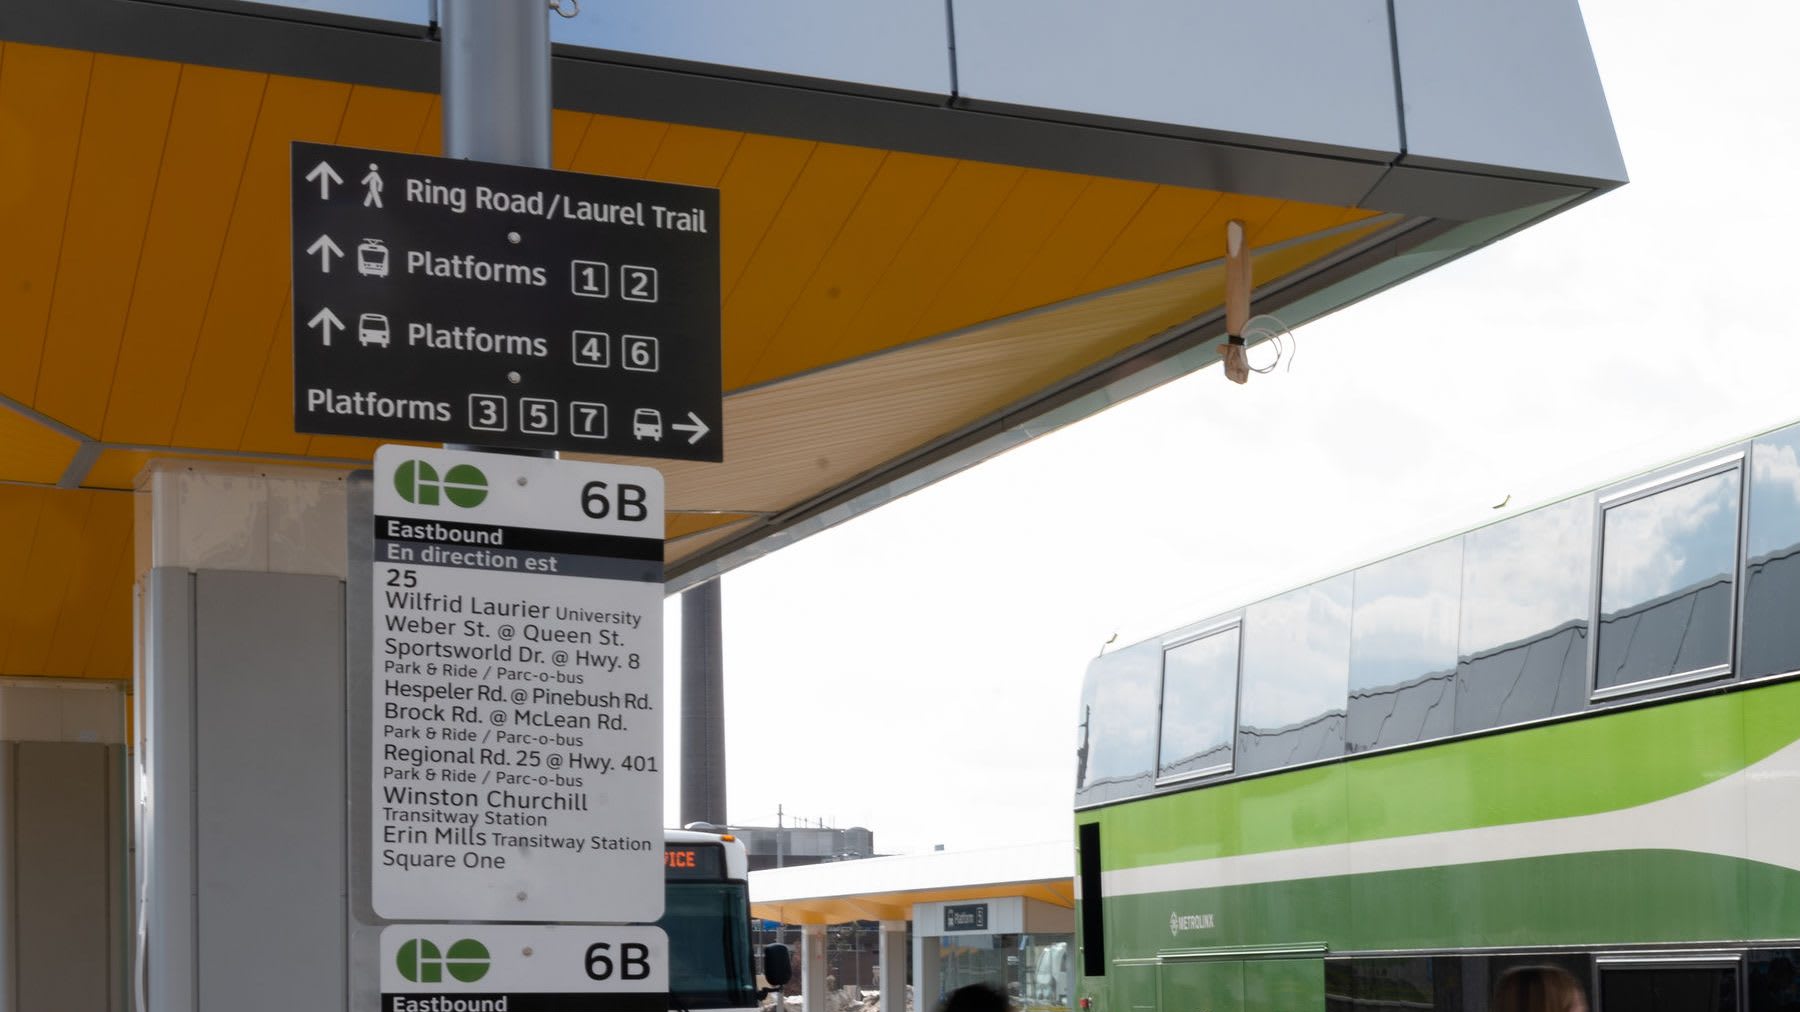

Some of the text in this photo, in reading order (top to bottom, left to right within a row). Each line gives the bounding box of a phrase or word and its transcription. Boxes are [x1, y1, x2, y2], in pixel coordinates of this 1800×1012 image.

[406, 179, 466, 213] Ring
[652, 204, 707, 233] Trail
[407, 251, 648, 297] Platforms 1 2
[408, 323, 648, 366] Platforms 4 6
[307, 388, 597, 432] Platforms 3 5 7
[580, 480, 648, 522] 6B
[387, 519, 504, 546] Eastbound
[387, 543, 558, 573] En direction est
[386, 569, 418, 588] 25
[385, 591, 642, 629] Wilfrid Laurier University
[385, 615, 624, 647] Weber St. @ Queen St.
[385, 638, 640, 672] Sportsworld Dr. @ Hwy. 8
[385, 661, 584, 685] Park & Ride / Parc-o-bus
[385, 680, 653, 711] Hespeler Rd. @ Pinebush Rd.
[385, 703, 627, 731] Brock Rd. @ McLean Rd.
[384, 725, 584, 747] Park & Ride / Parc-o-bus
[384, 744, 658, 775] Regional Rd. 25 @ Hwy. 401
[384, 766, 583, 788] Park & Ride / Parc-o-bus
[384, 786, 588, 811] Winston Churchill
[383, 808, 547, 827] Transitway Station
[383, 826, 652, 853] Erin Mills Transitway Station
[383, 850, 506, 871] Square One
[1179, 914, 1215, 930] METROLINX
[584, 942, 651, 981] 6B
[392, 995, 508, 1012] Eastbound
